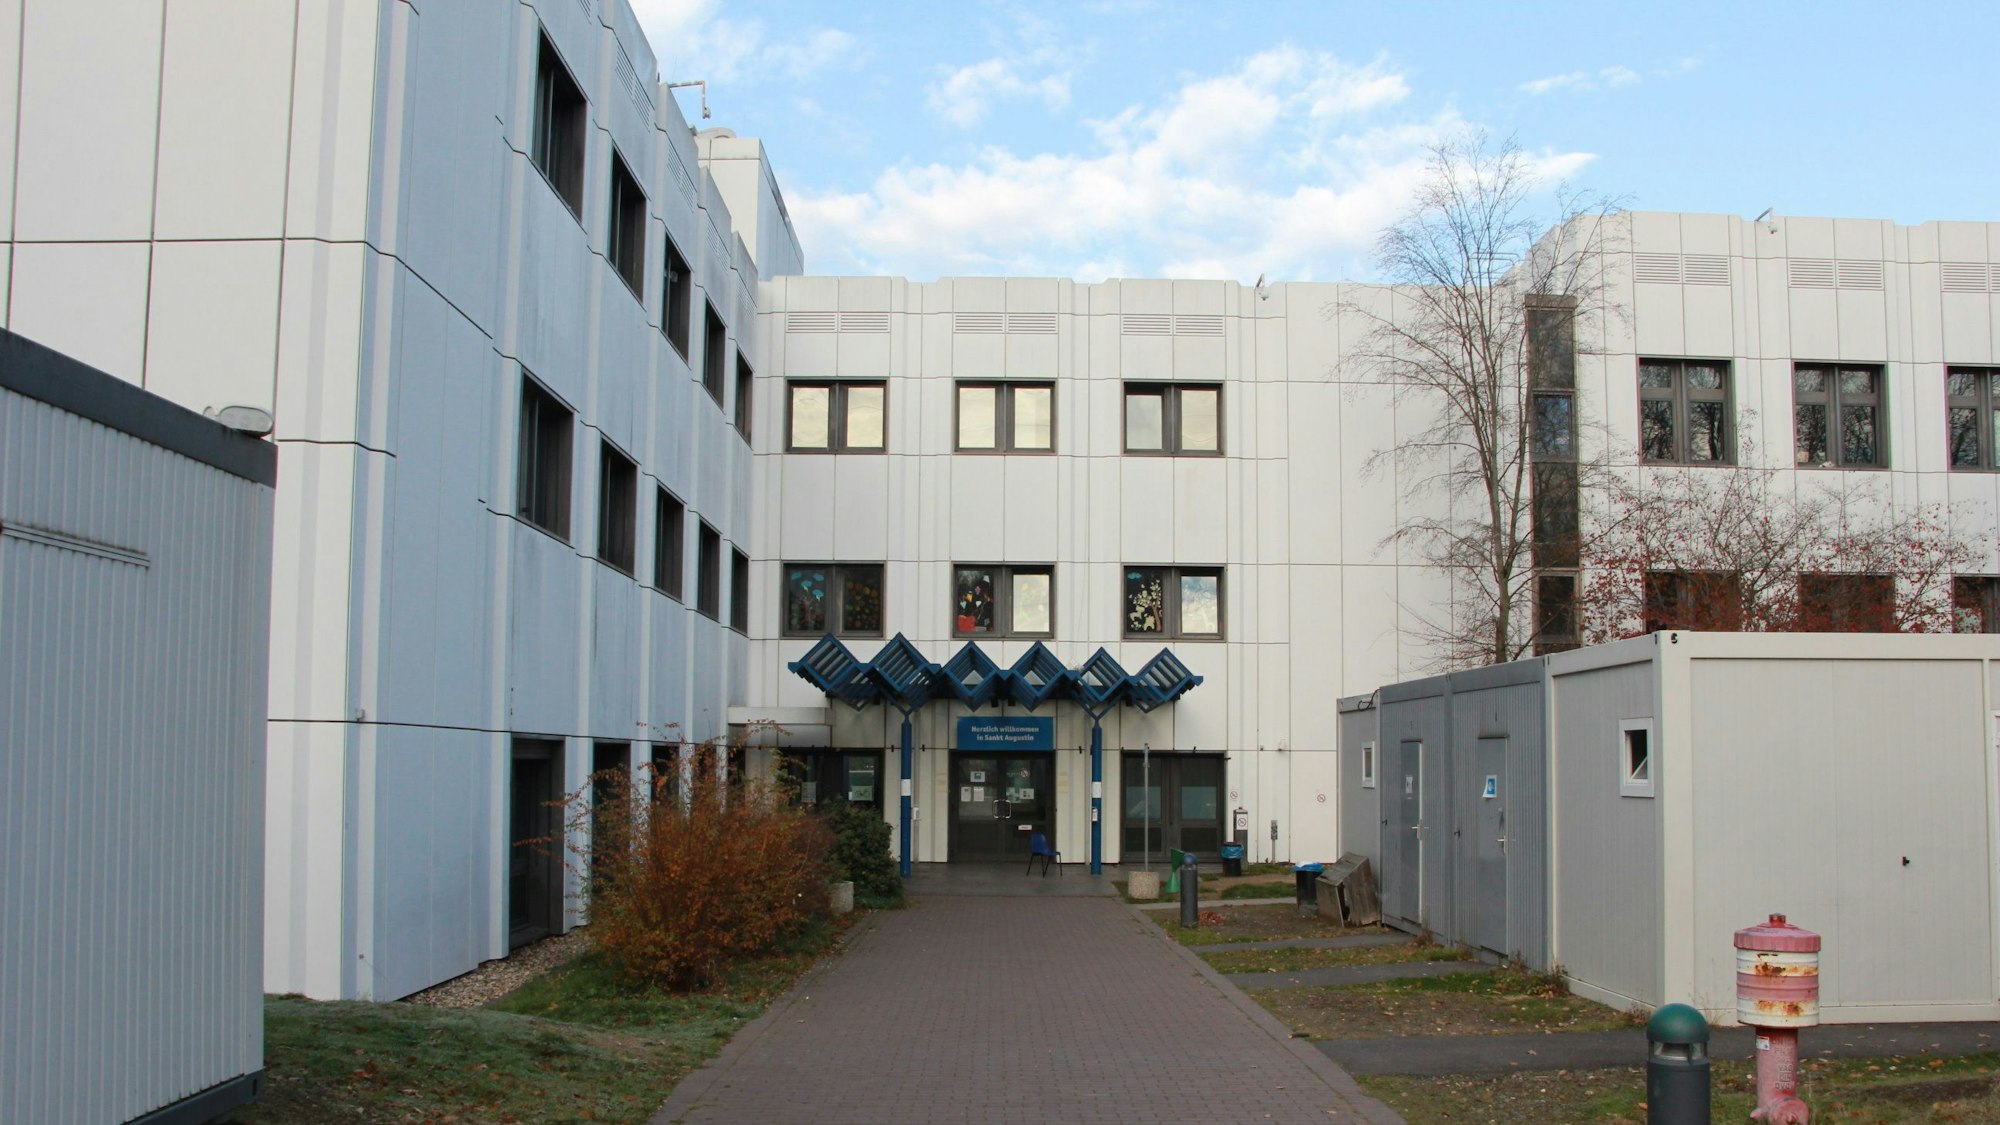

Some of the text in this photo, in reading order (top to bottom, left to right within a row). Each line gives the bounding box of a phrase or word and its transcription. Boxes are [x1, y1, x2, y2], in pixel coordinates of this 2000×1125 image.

[971, 725, 1039, 733] Herzlich willkommen
[1004, 734, 1034, 743] Augustin
